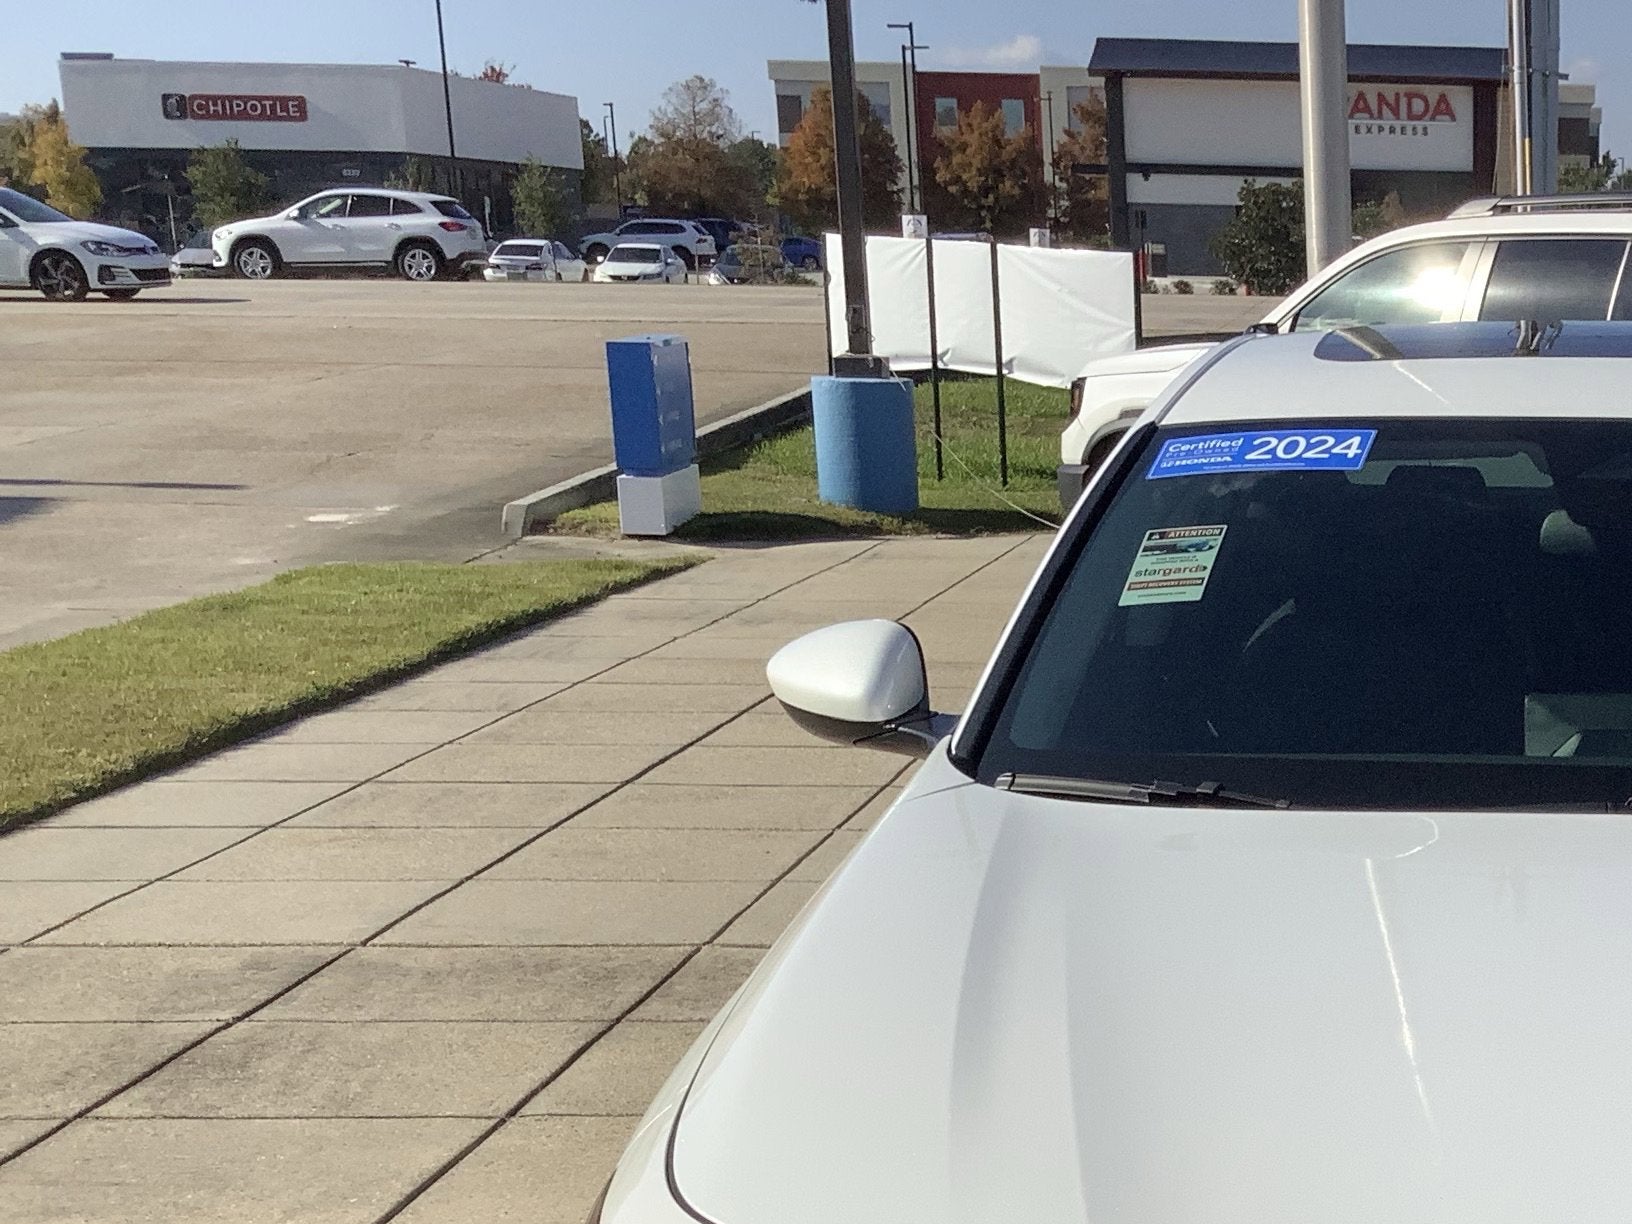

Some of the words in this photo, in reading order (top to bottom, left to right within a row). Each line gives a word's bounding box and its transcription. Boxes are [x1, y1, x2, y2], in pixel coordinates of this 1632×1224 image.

[193, 100, 300, 116] CHIPOTLE
[1347, 91, 1456, 121] ANDA
[1354, 125, 1429, 136] EXPRESS
[1168, 437, 1244, 452] Certified
[1245, 435, 1363, 460] 2024
[1173, 456, 1233, 466] HONDA
[1168, 528, 1221, 538] ATTENTION
